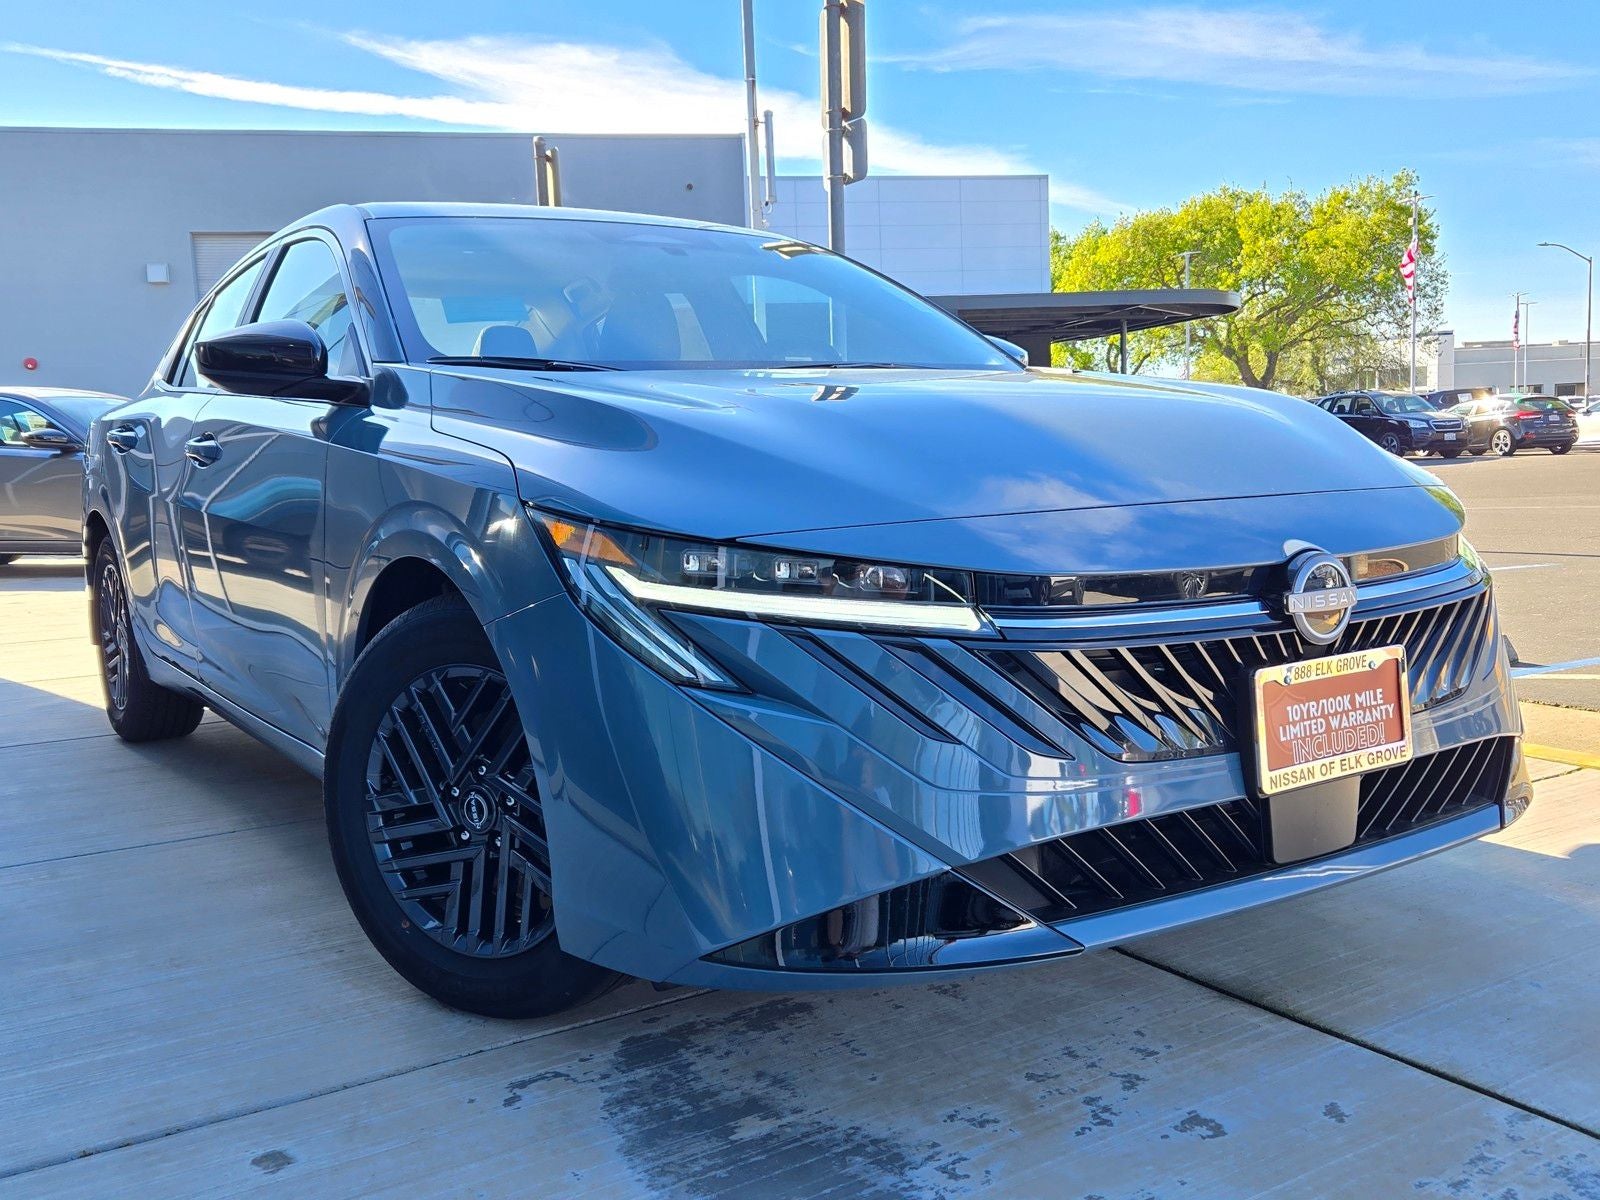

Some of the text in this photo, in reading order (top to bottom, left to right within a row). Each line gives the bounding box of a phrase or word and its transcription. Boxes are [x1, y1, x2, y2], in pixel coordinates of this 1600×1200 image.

[1291, 590, 1357, 610] NISSAN
[1294, 654, 1368, 681] 888 ELK GROVE
[1279, 703, 1395, 742] LIMITED WARRANTY
[1286, 688, 1384, 722] 10YR/100K MILE
[1292, 722, 1386, 765] INCLUDED!
[1269, 744, 1407, 791] NISSAN OF ELK GROVE
[469, 791, 481, 829] NISSAN
